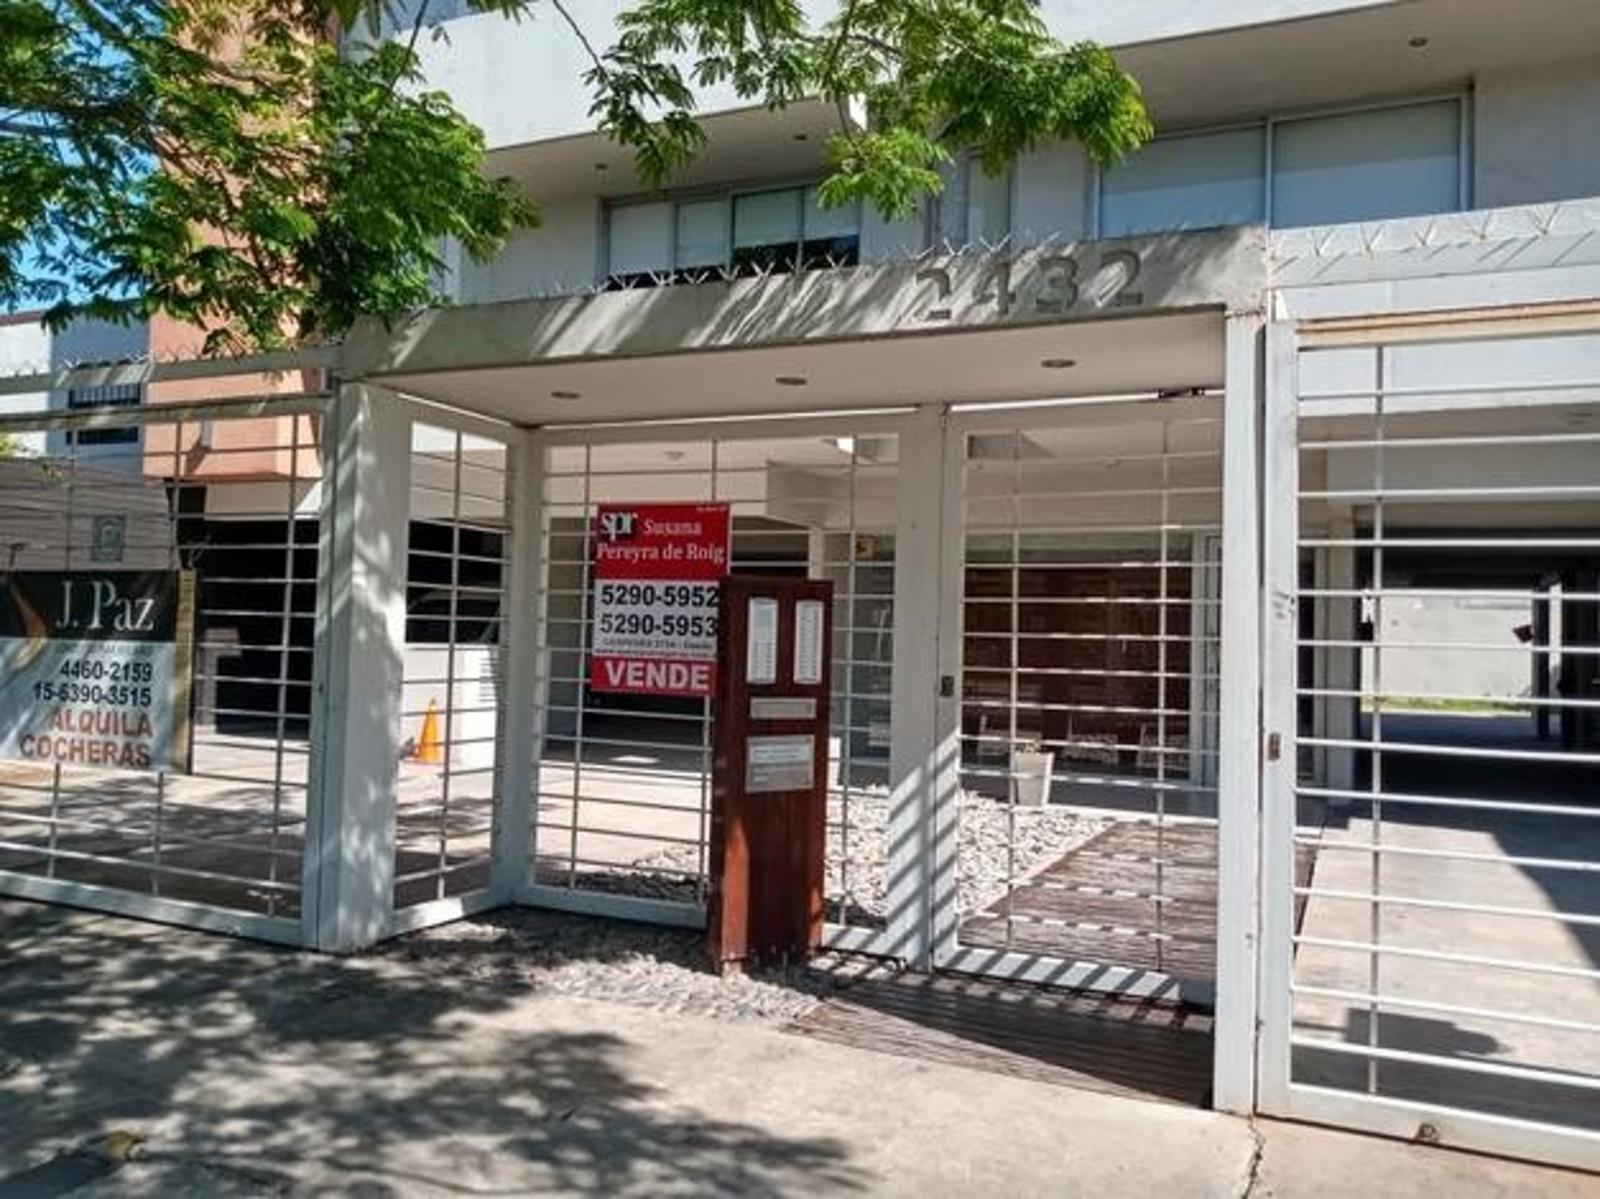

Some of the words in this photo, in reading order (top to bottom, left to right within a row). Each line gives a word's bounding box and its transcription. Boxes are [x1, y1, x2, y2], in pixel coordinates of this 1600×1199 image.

[915, 250, 1144, 320] 2432
[596, 543, 659, 564] Pereyra
[662, 543, 683, 560] de
[686, 543, 725, 563] Roig
[56, 580, 78, 628] J.
[88, 580, 155, 631] Paz
[601, 584, 719, 608] 5290-5952
[600, 613, 717, 638] 5290-5953
[59, 660, 154, 683] 4460-2159
[604, 660, 711, 691] VENDE
[50, 709, 154, 738] ALQUILA
[20, 734, 152, 767] COCHERAS
